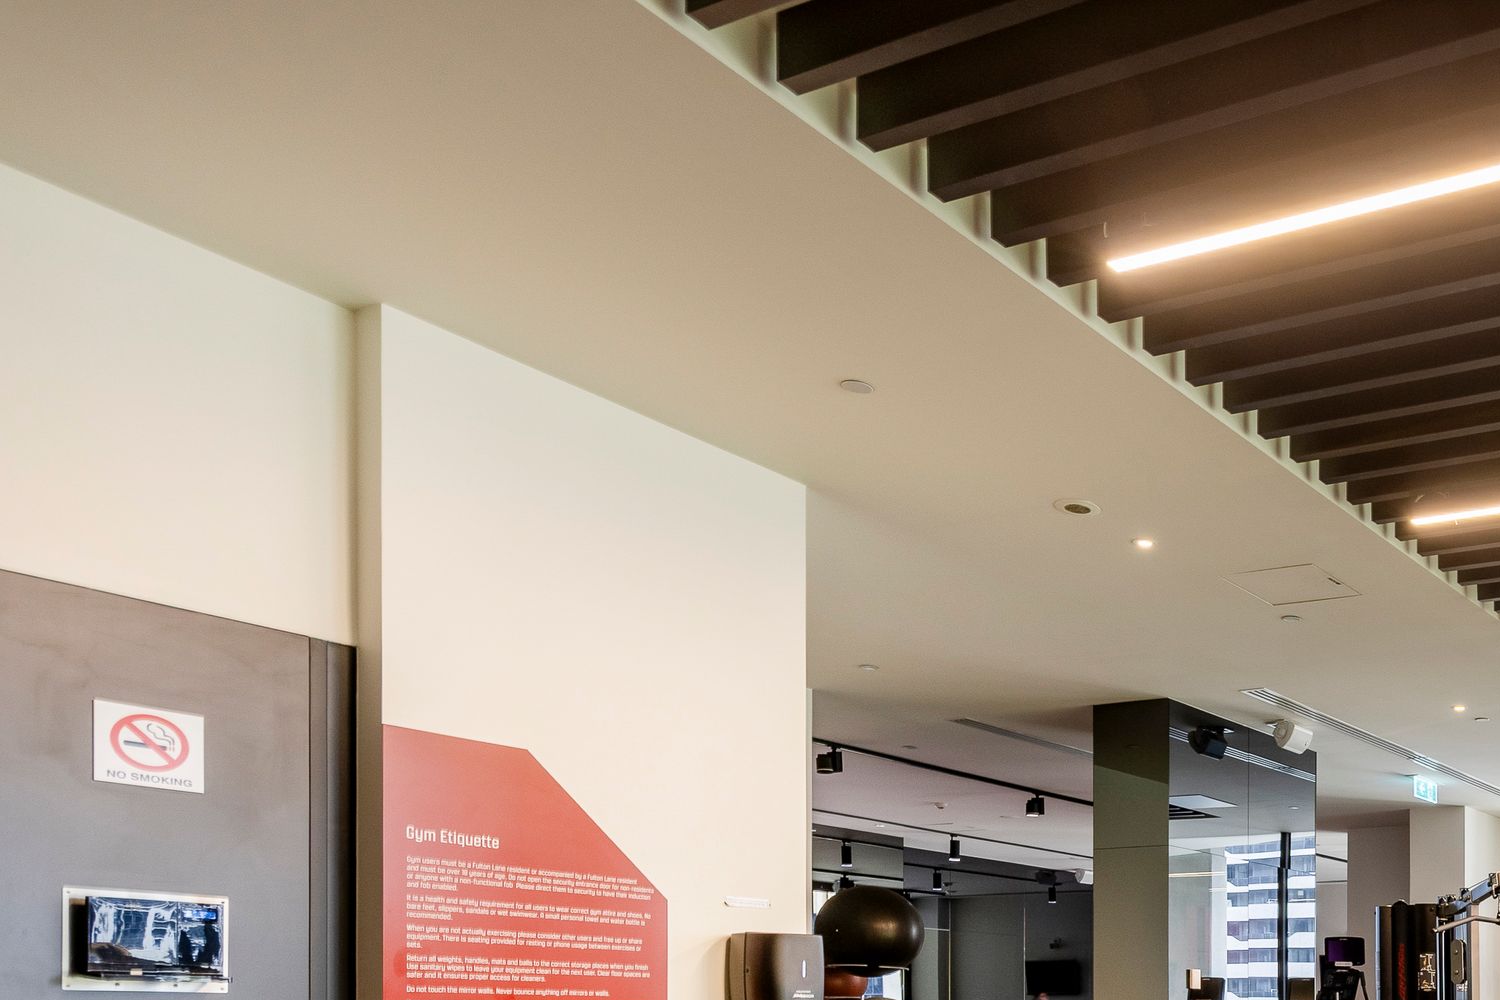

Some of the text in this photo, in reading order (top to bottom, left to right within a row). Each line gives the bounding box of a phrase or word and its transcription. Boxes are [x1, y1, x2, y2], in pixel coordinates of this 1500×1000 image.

[106, 769, 193, 787] NO SMOKING
[405, 825, 500, 849] Gym Etiquette
